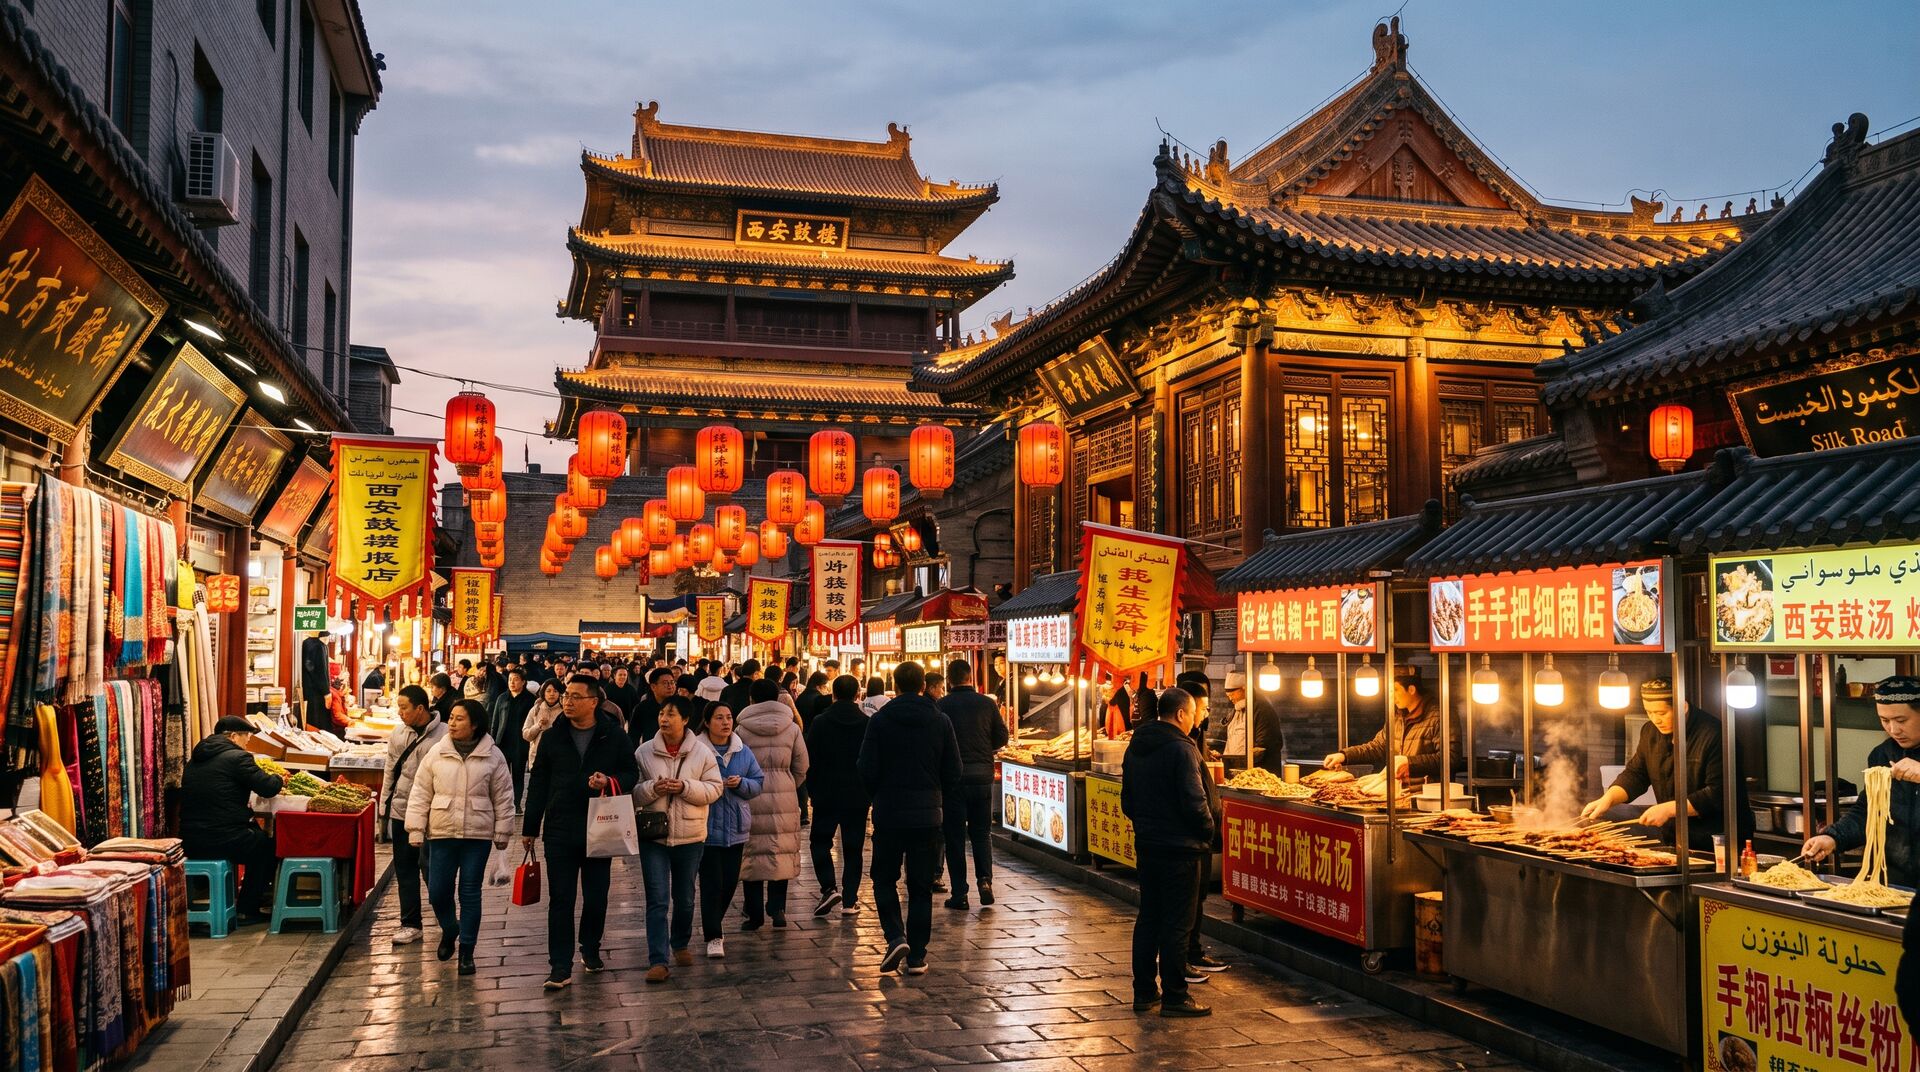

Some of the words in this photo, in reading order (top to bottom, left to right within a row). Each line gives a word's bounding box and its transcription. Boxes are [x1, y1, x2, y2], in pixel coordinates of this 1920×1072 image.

[747, 219, 838, 245] 西安鼓楼
[1811, 431, 1849, 452] Silk
[1850, 419, 1907, 445] Road
[1782, 598, 1894, 641] 西安鼓汤
